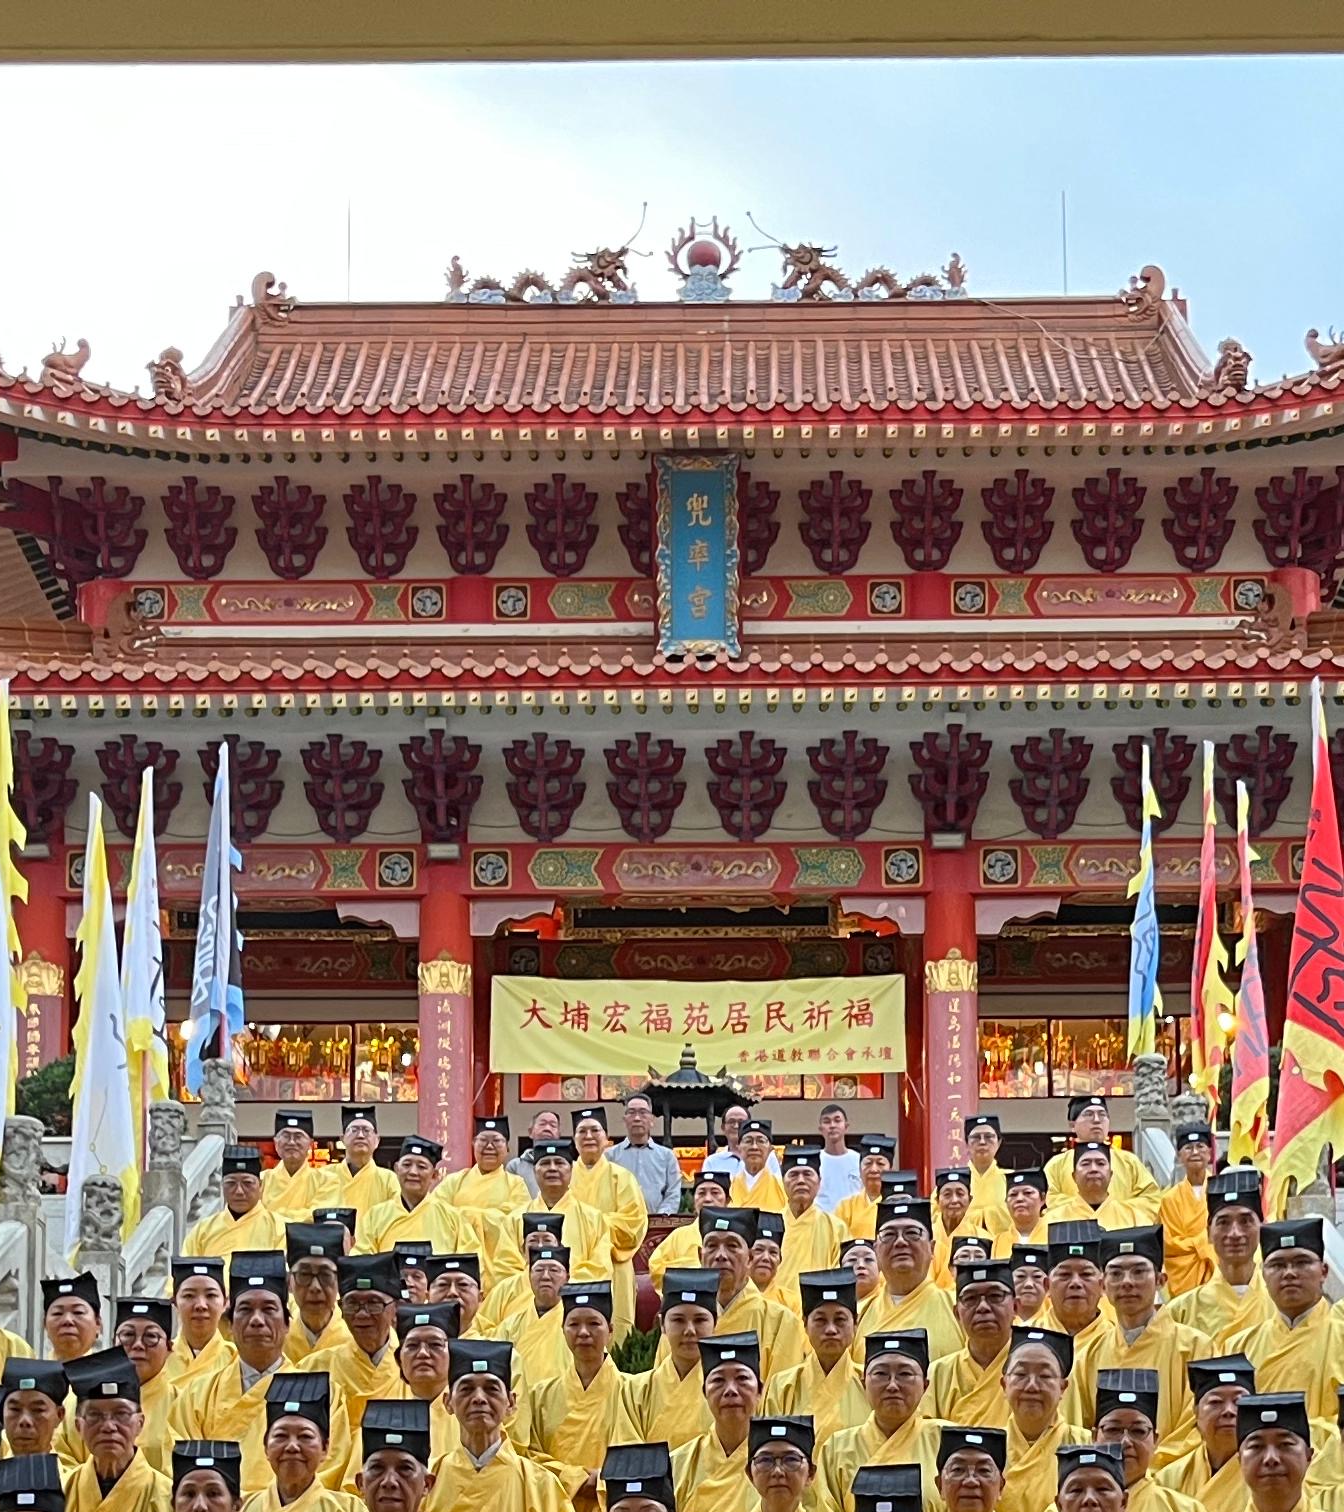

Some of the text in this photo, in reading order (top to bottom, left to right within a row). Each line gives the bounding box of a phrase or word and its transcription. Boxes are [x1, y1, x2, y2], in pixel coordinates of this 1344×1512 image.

[686, 493, 712, 619] 兜率宮
[519, 997, 874, 1036] 大埔宏福苑居民祈福
[737, 1045, 893, 1063] 香港道教聯合會承壇
